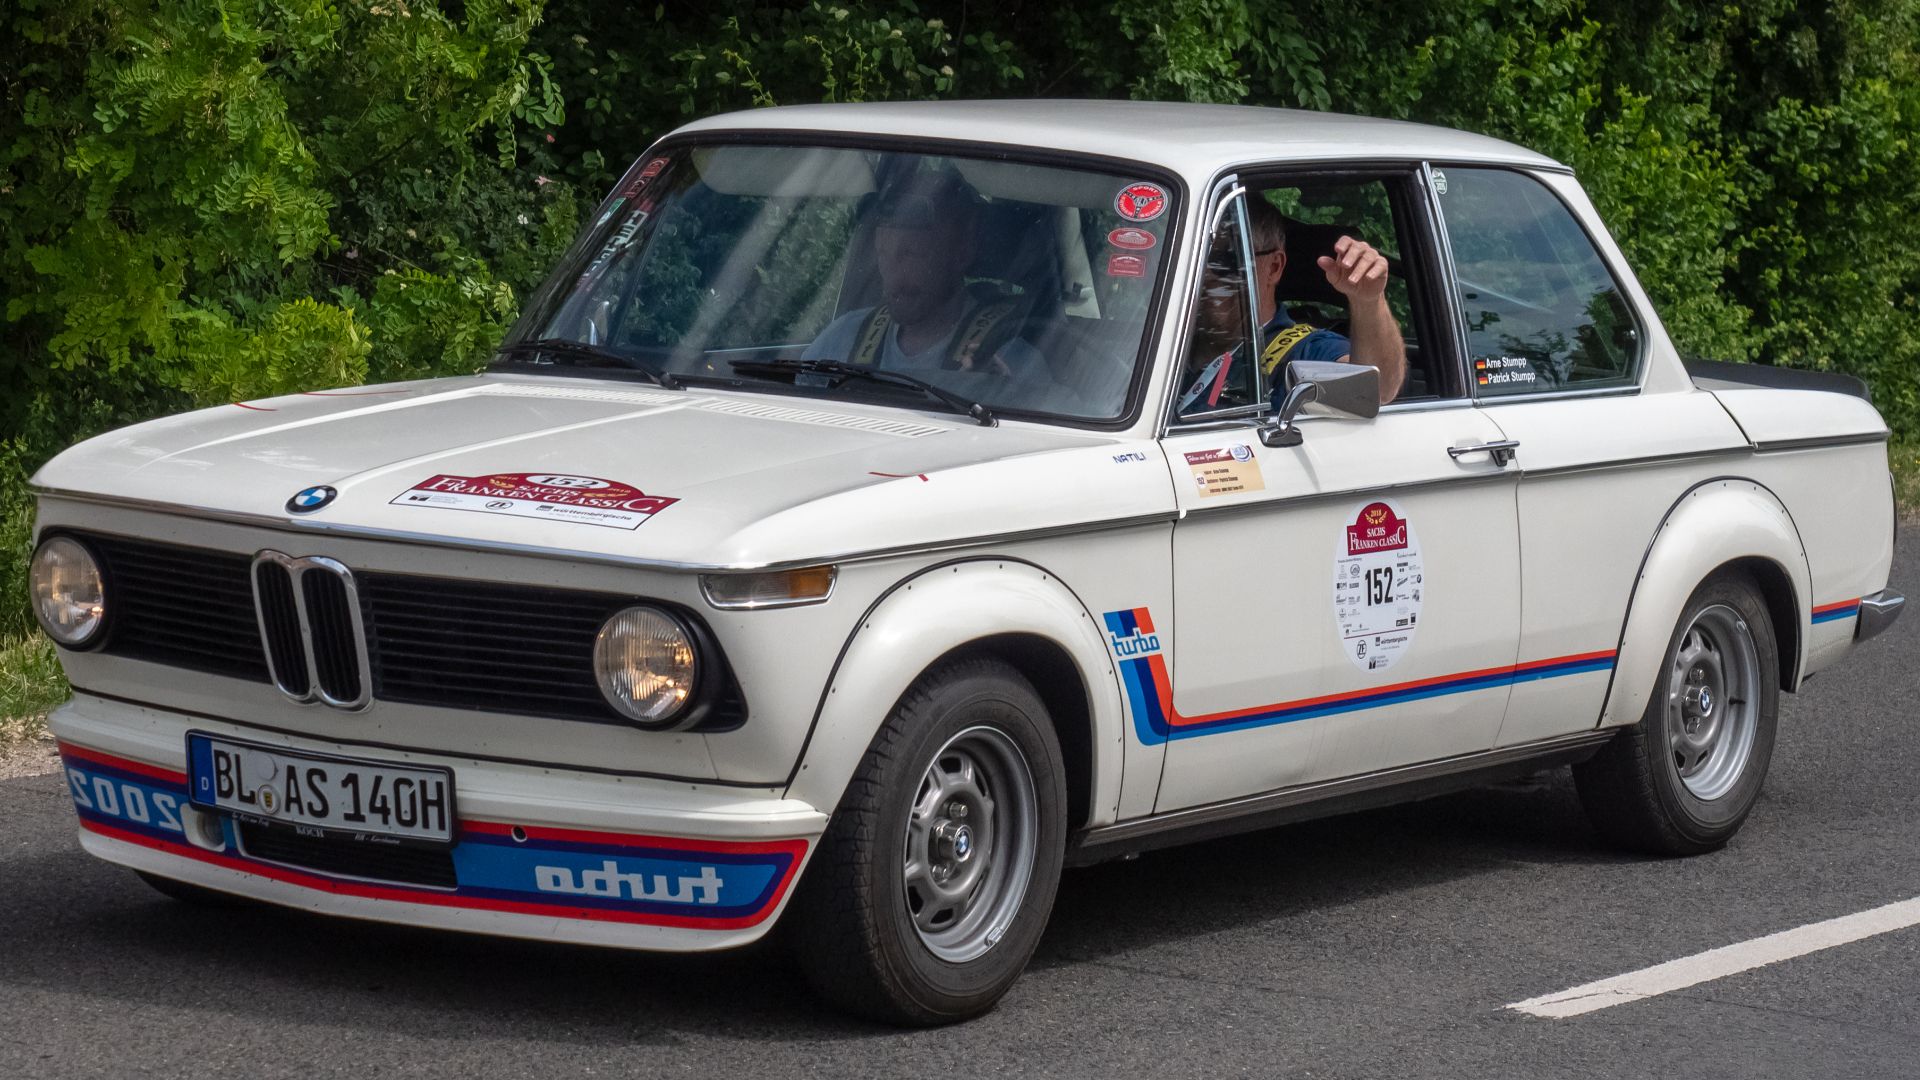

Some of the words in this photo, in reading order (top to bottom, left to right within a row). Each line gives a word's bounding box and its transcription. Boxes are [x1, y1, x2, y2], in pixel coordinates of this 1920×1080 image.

[1486, 358, 1501, 368] Arne
[1502, 356, 1526, 369] Stumpp
[1488, 372, 1510, 384] Patrick
[1511, 371, 1536, 383] Stumpp
[540, 476, 599, 488] 152
[424, 477, 544, 499] FRANKEN
[543, 493, 664, 511] CLASSIC
[515, 485, 581, 497] SACHS
[1349, 532, 1378, 551] FRANKEN
[1379, 526, 1405, 546] CLASSIC
[1367, 527, 1386, 537] SACHS
[1365, 567, 1394, 606] 152
[1110, 629, 1161, 656] turbo
[201, 777, 209, 791] D
[213, 749, 256, 805] BL
[285, 765, 329, 818] AS
[341, 773, 446, 831] 140H
